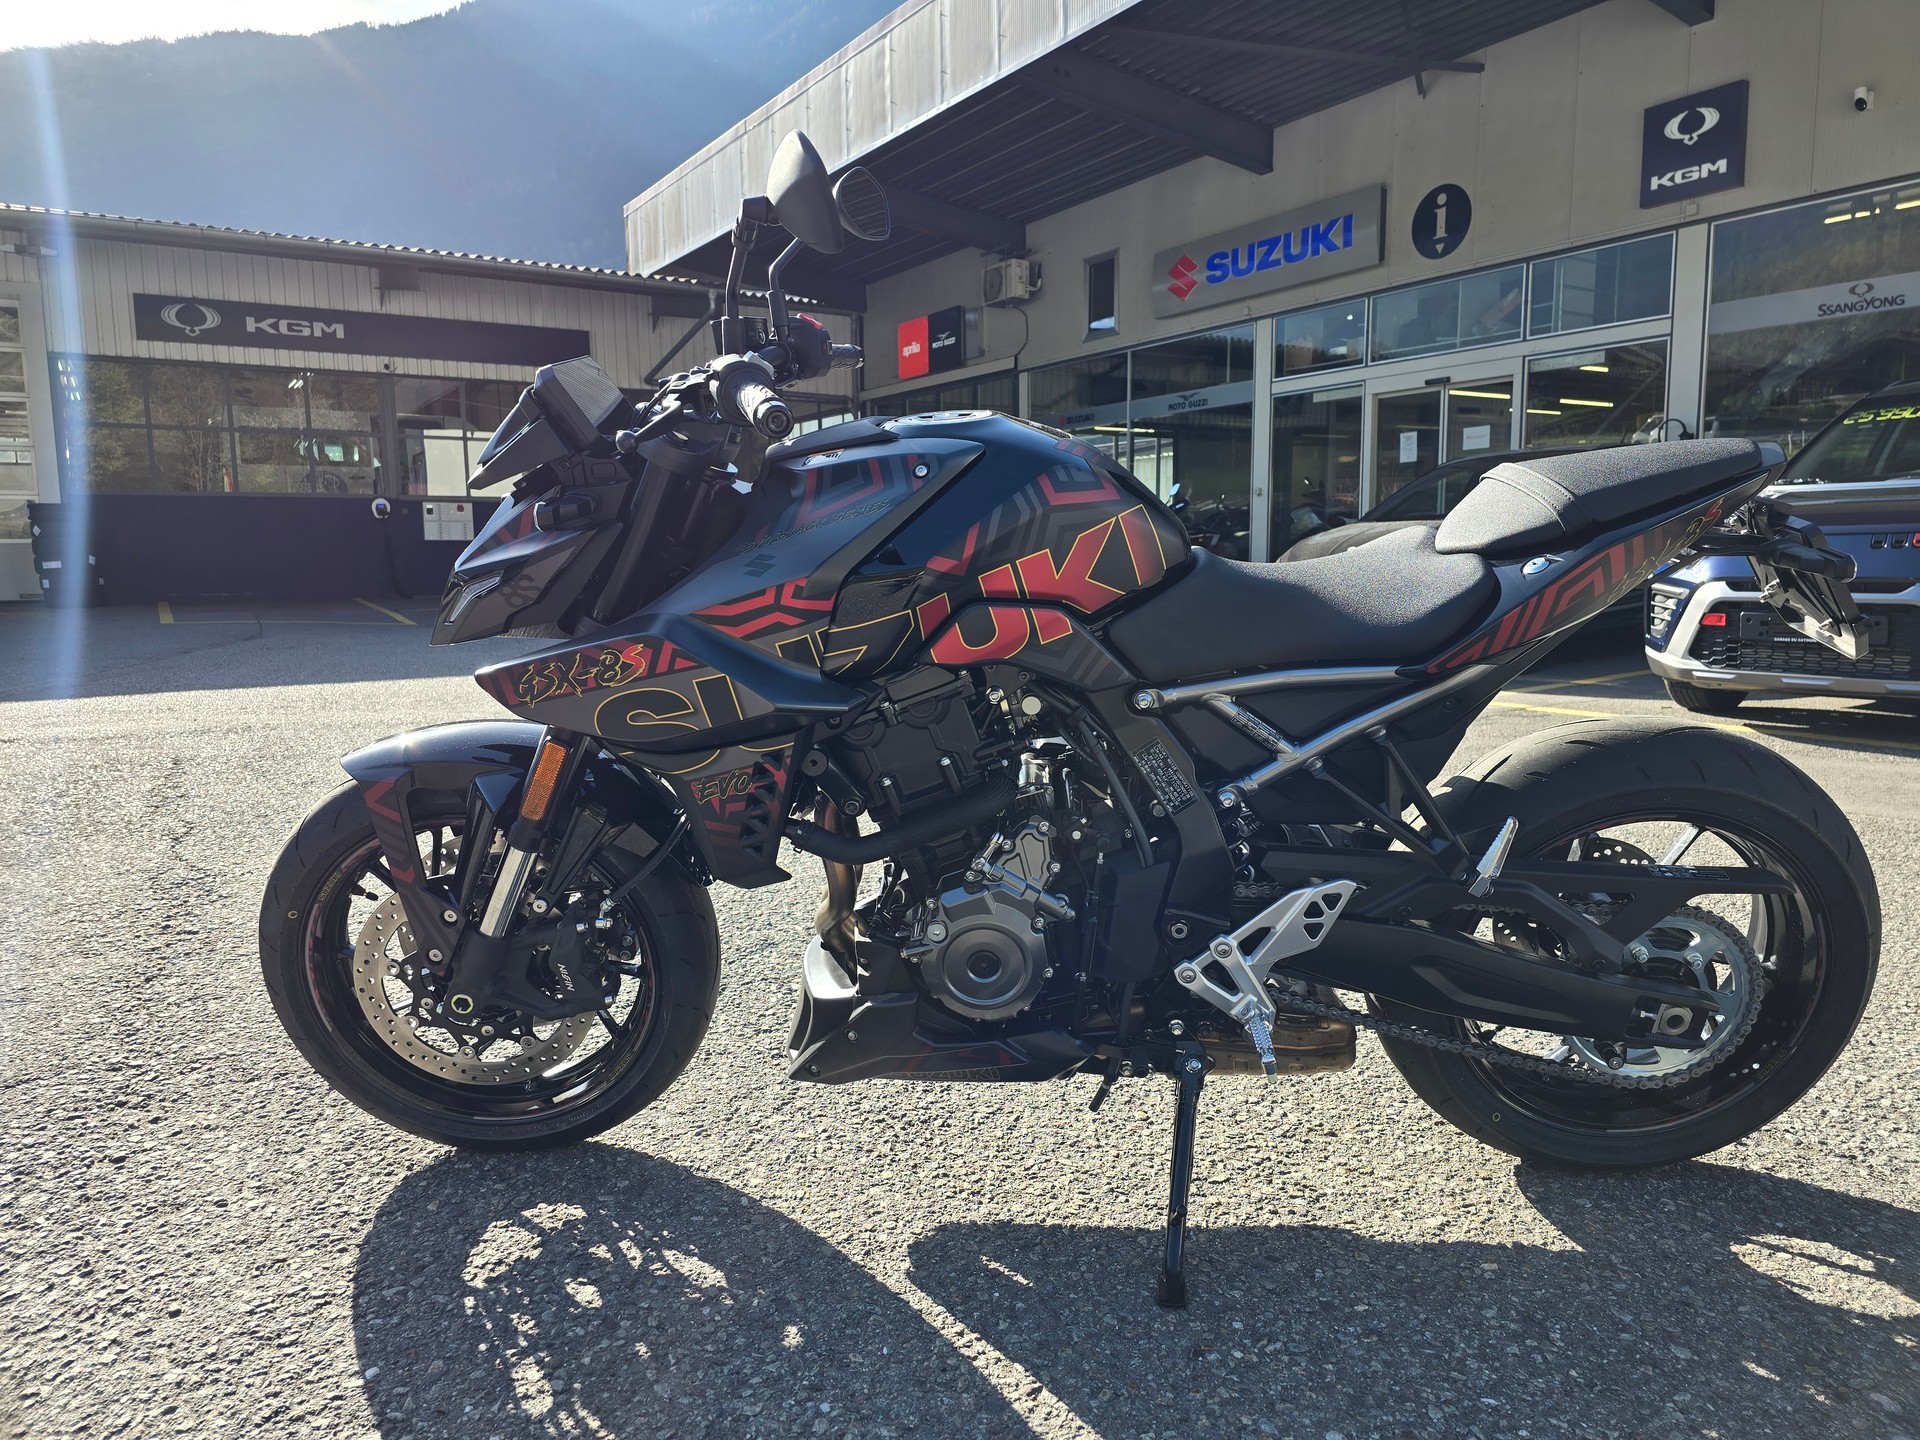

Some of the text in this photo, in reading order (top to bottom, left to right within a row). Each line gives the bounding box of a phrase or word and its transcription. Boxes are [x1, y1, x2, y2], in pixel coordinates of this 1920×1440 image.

[1650, 158, 1727, 191] KGM
[1205, 213, 1354, 284] SUZUKI
[246, 316, 344, 339] KGM
[1066, 413, 1094, 424] SUZUKI
[1168, 398, 1208, 412] MOTO GUZZI
[516, 643, 647, 709] GSX-8S
[695, 768, 753, 805] EVO
[318, 870, 342, 901] SUZUKI
